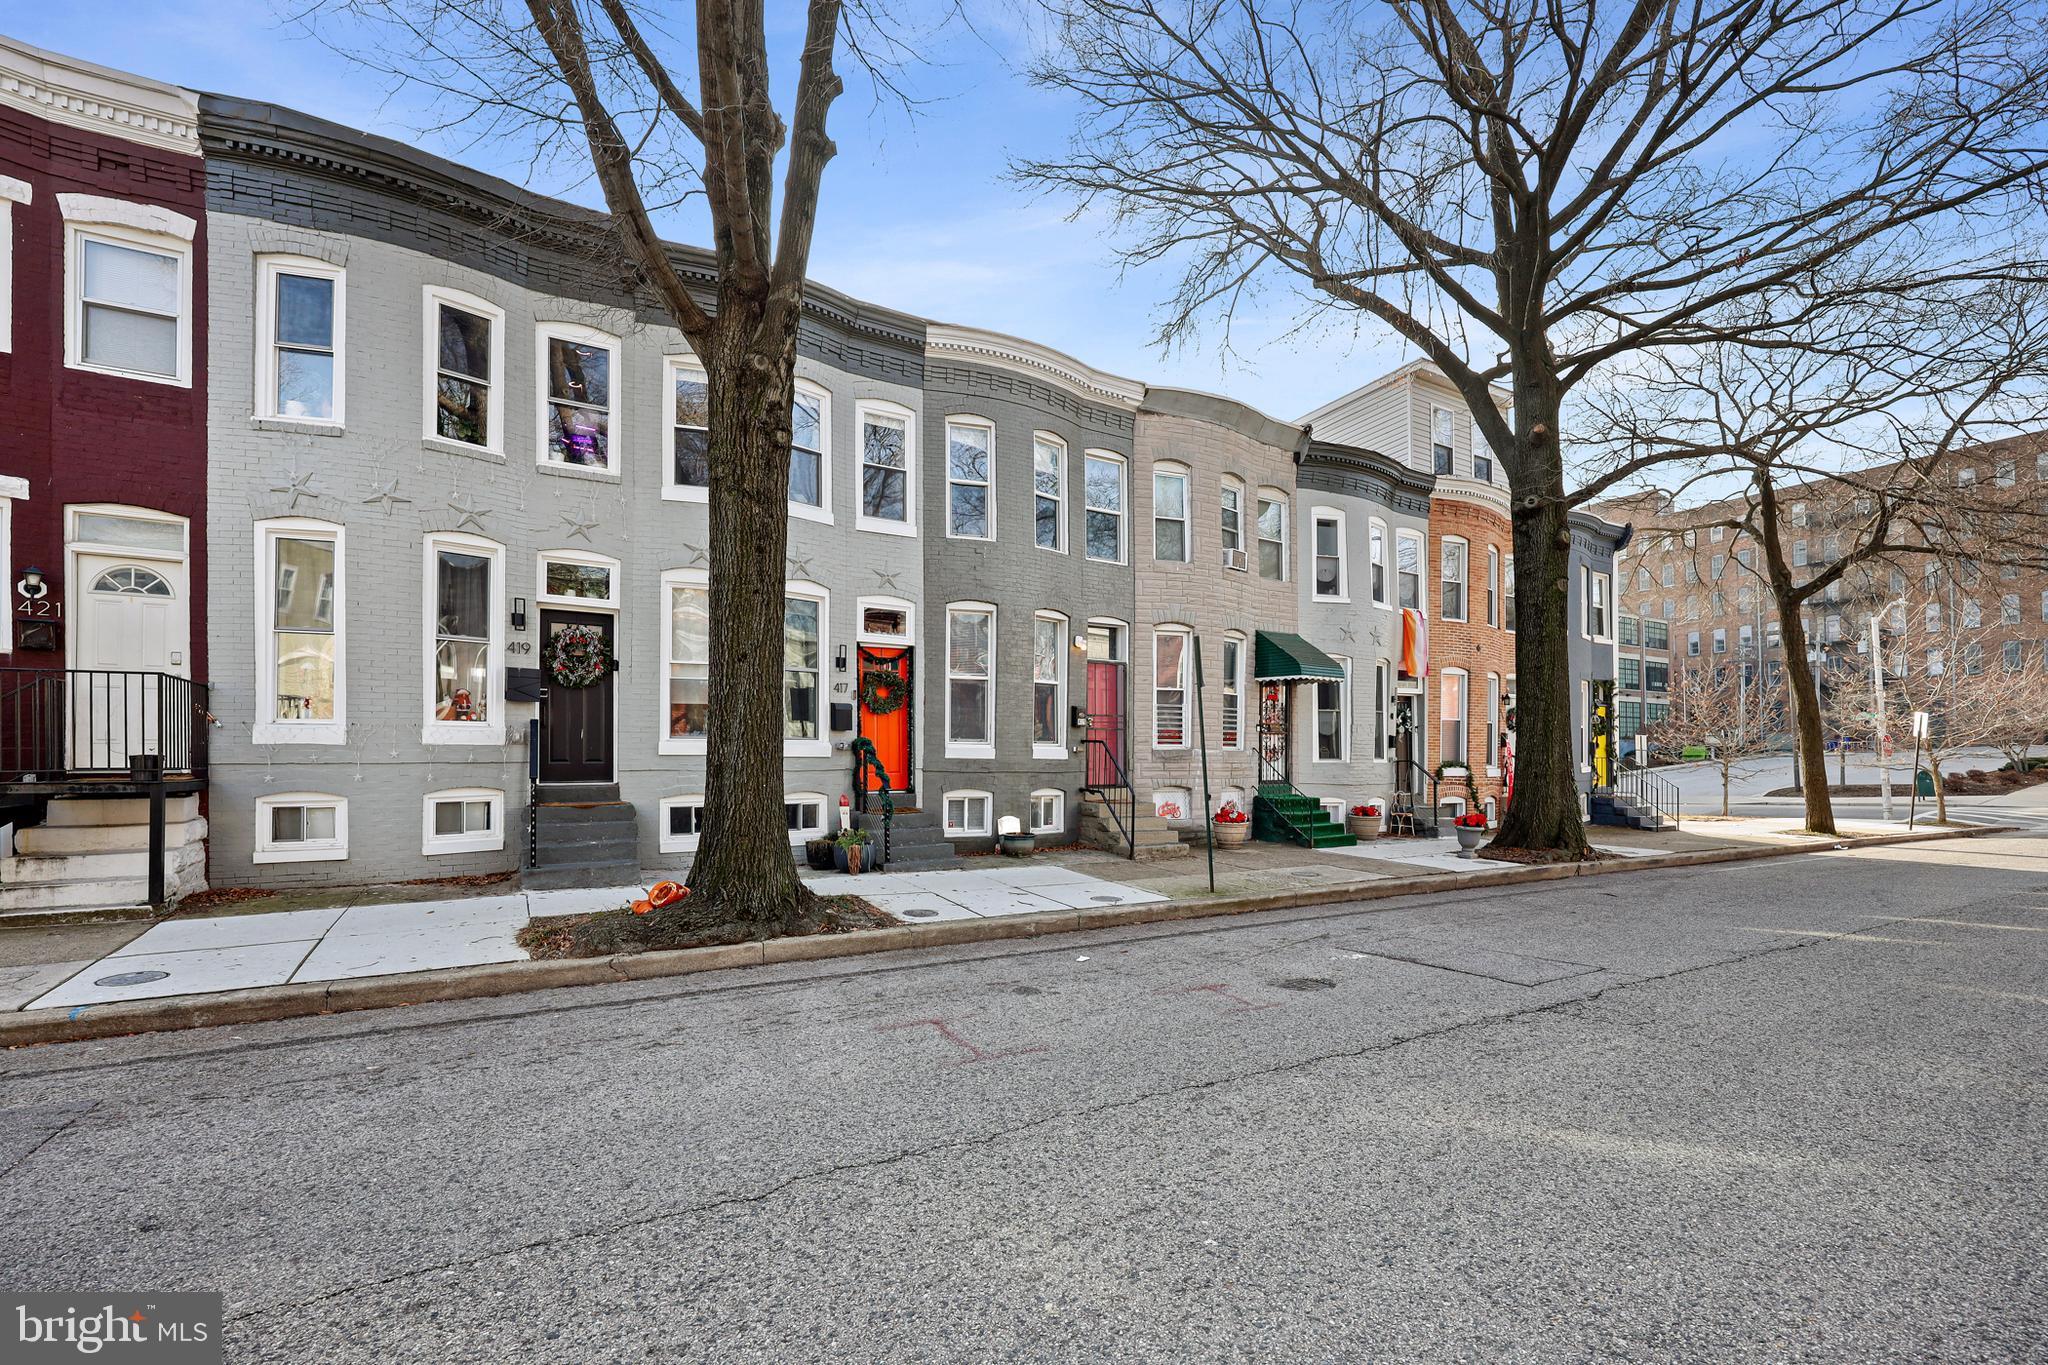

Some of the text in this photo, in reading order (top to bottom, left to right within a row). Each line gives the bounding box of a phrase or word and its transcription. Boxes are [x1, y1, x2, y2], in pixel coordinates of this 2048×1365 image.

[17, 600, 61, 618] 421
[506, 641, 531, 655] 419
[833, 682, 849, 694] 417
